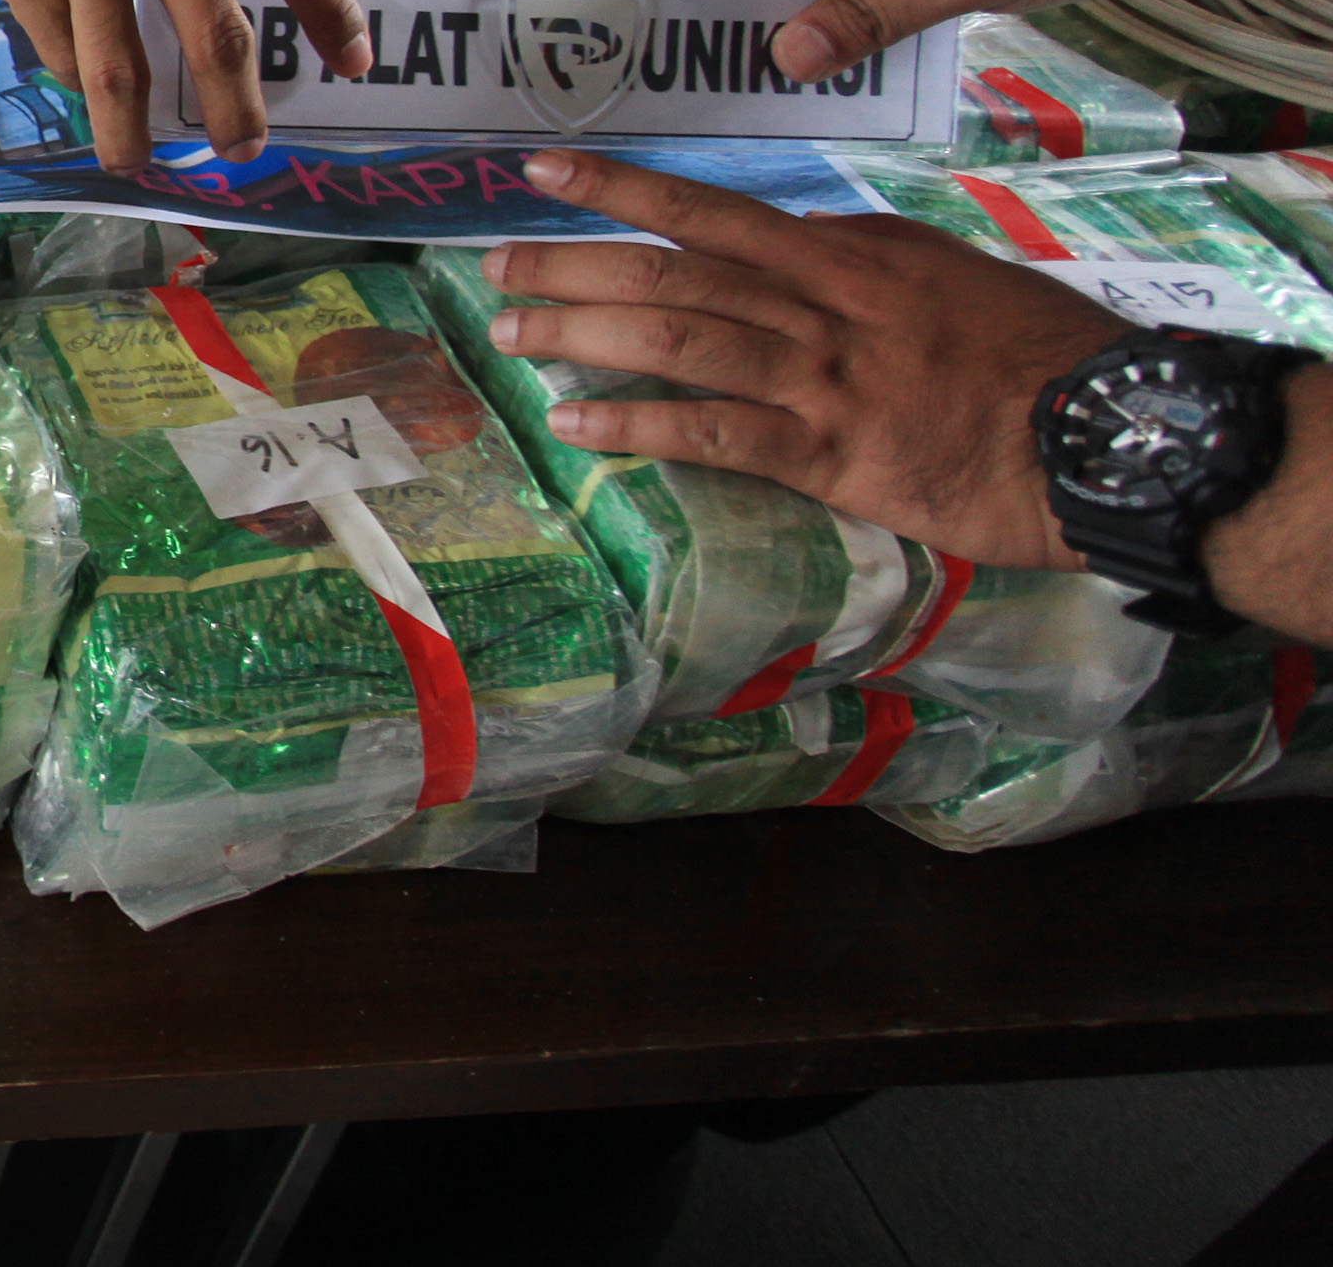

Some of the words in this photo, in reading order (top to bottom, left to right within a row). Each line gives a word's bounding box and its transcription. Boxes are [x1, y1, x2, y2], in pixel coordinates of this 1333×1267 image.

[241, 5, 300, 82] B
[287, 152, 547, 207] KAPA
[1097, 277, 1214, 310] A.15
[239, 416, 362, 473] A.16
